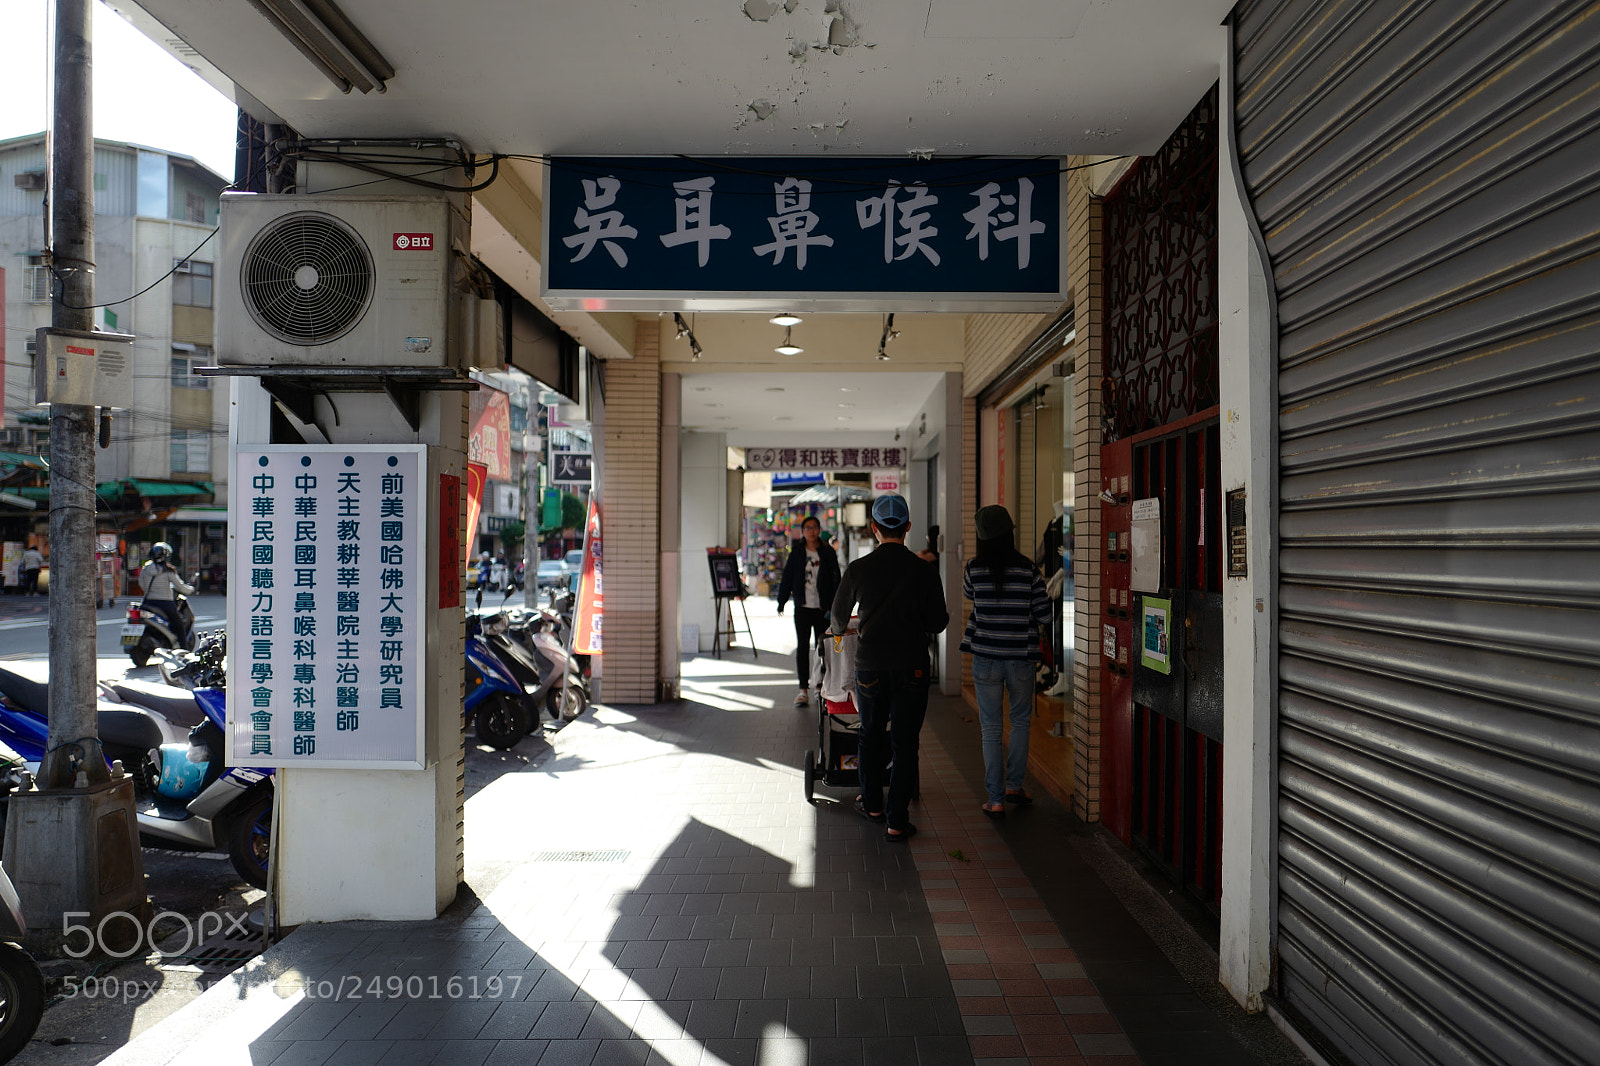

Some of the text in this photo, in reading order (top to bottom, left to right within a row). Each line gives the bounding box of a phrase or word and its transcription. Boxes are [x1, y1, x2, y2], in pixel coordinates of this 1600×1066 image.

[411, 237, 431, 247] 日立
[562, 175, 1046, 270] 吳耳鼻喉科
[778, 448, 902, 468] 得和珠寶銀樓
[250, 473, 275, 756] 中華民國聽力語言學會會員
[293, 473, 317, 756] 中華民國耳鼻喉科專科醫師
[336, 472, 361, 732] 天主教耕莘醫院主治醫師
[379, 473, 404, 710] 前美國哈佛大學研究員
